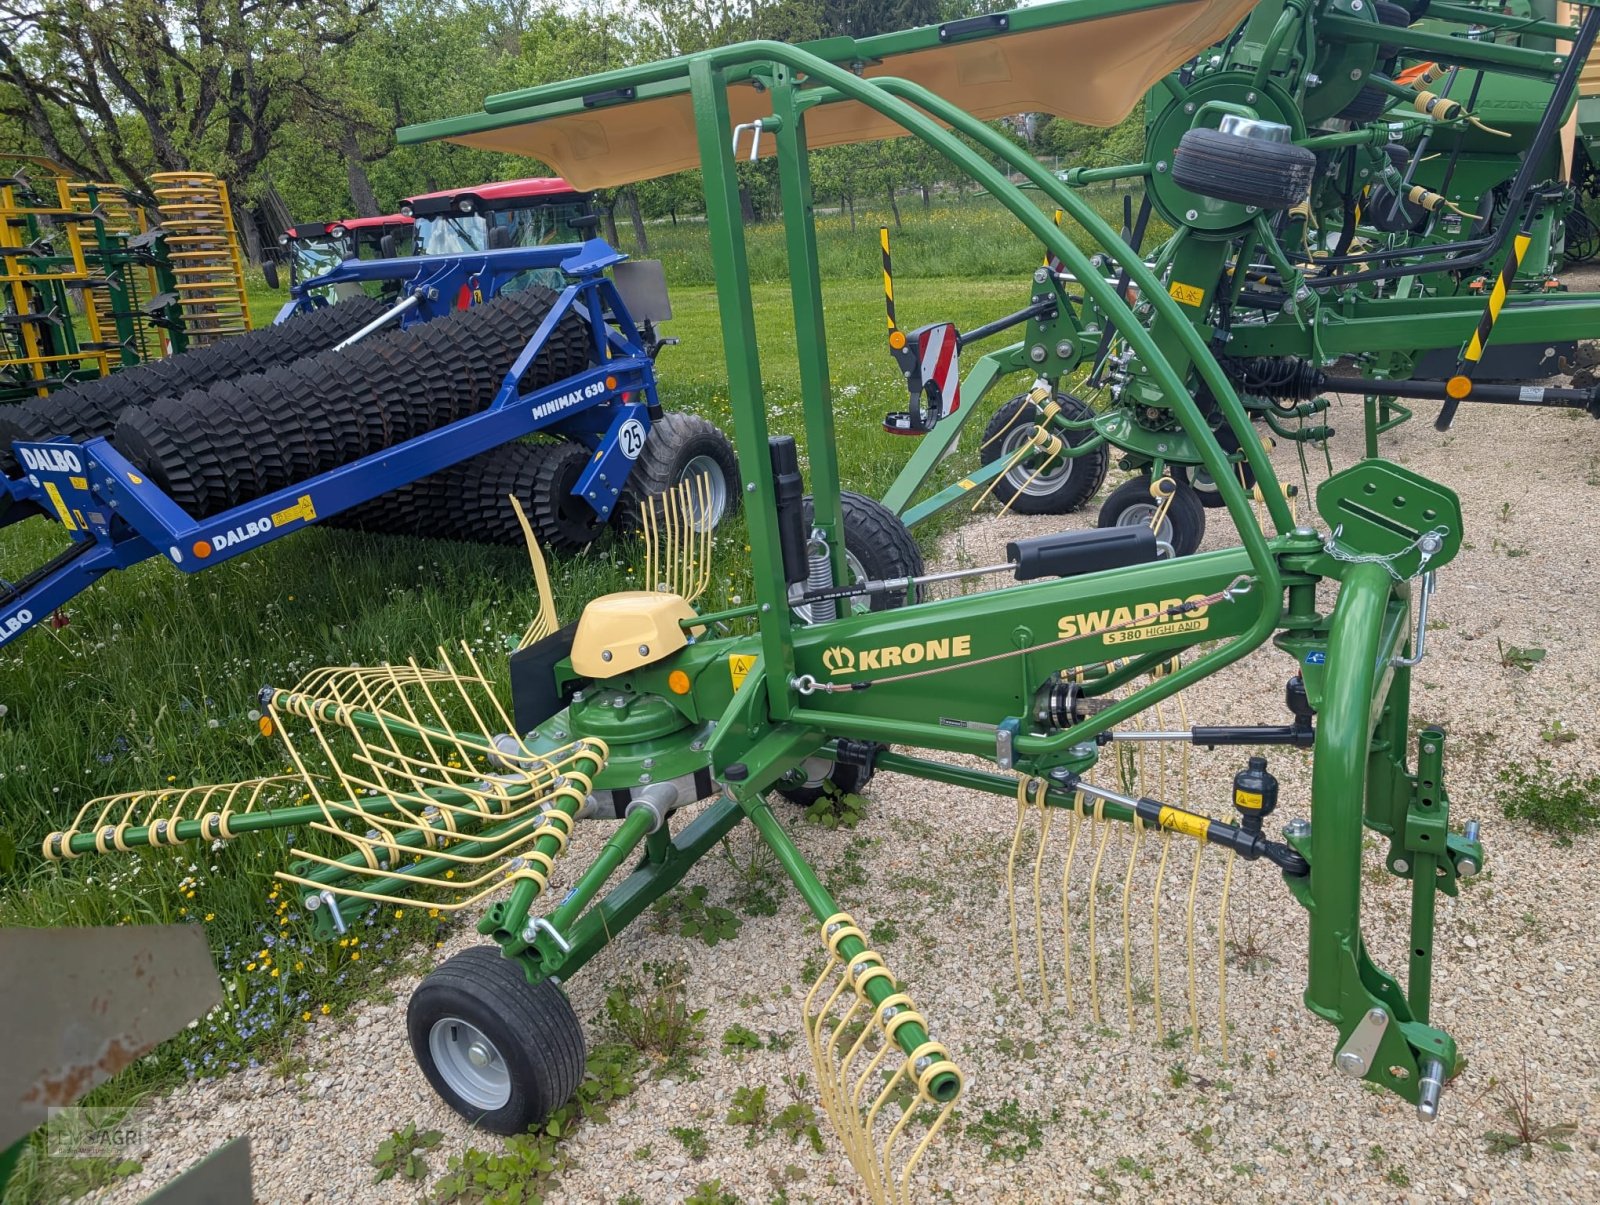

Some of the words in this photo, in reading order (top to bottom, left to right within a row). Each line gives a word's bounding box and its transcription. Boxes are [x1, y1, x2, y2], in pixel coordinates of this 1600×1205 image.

[531, 388, 585, 421] MINIMAX
[584, 381, 605, 399] 630
[623, 424, 642, 454] 25
[20, 447, 82, 473] DALBO
[211, 517, 272, 551] DALBO
[1057, 594, 1210, 638] SWADRO
[1108, 633, 1116, 643] S
[1119, 629, 1142, 642] 380
[1145, 620, 1202, 637] HIGHLAND
[859, 634, 971, 671] KRONE
